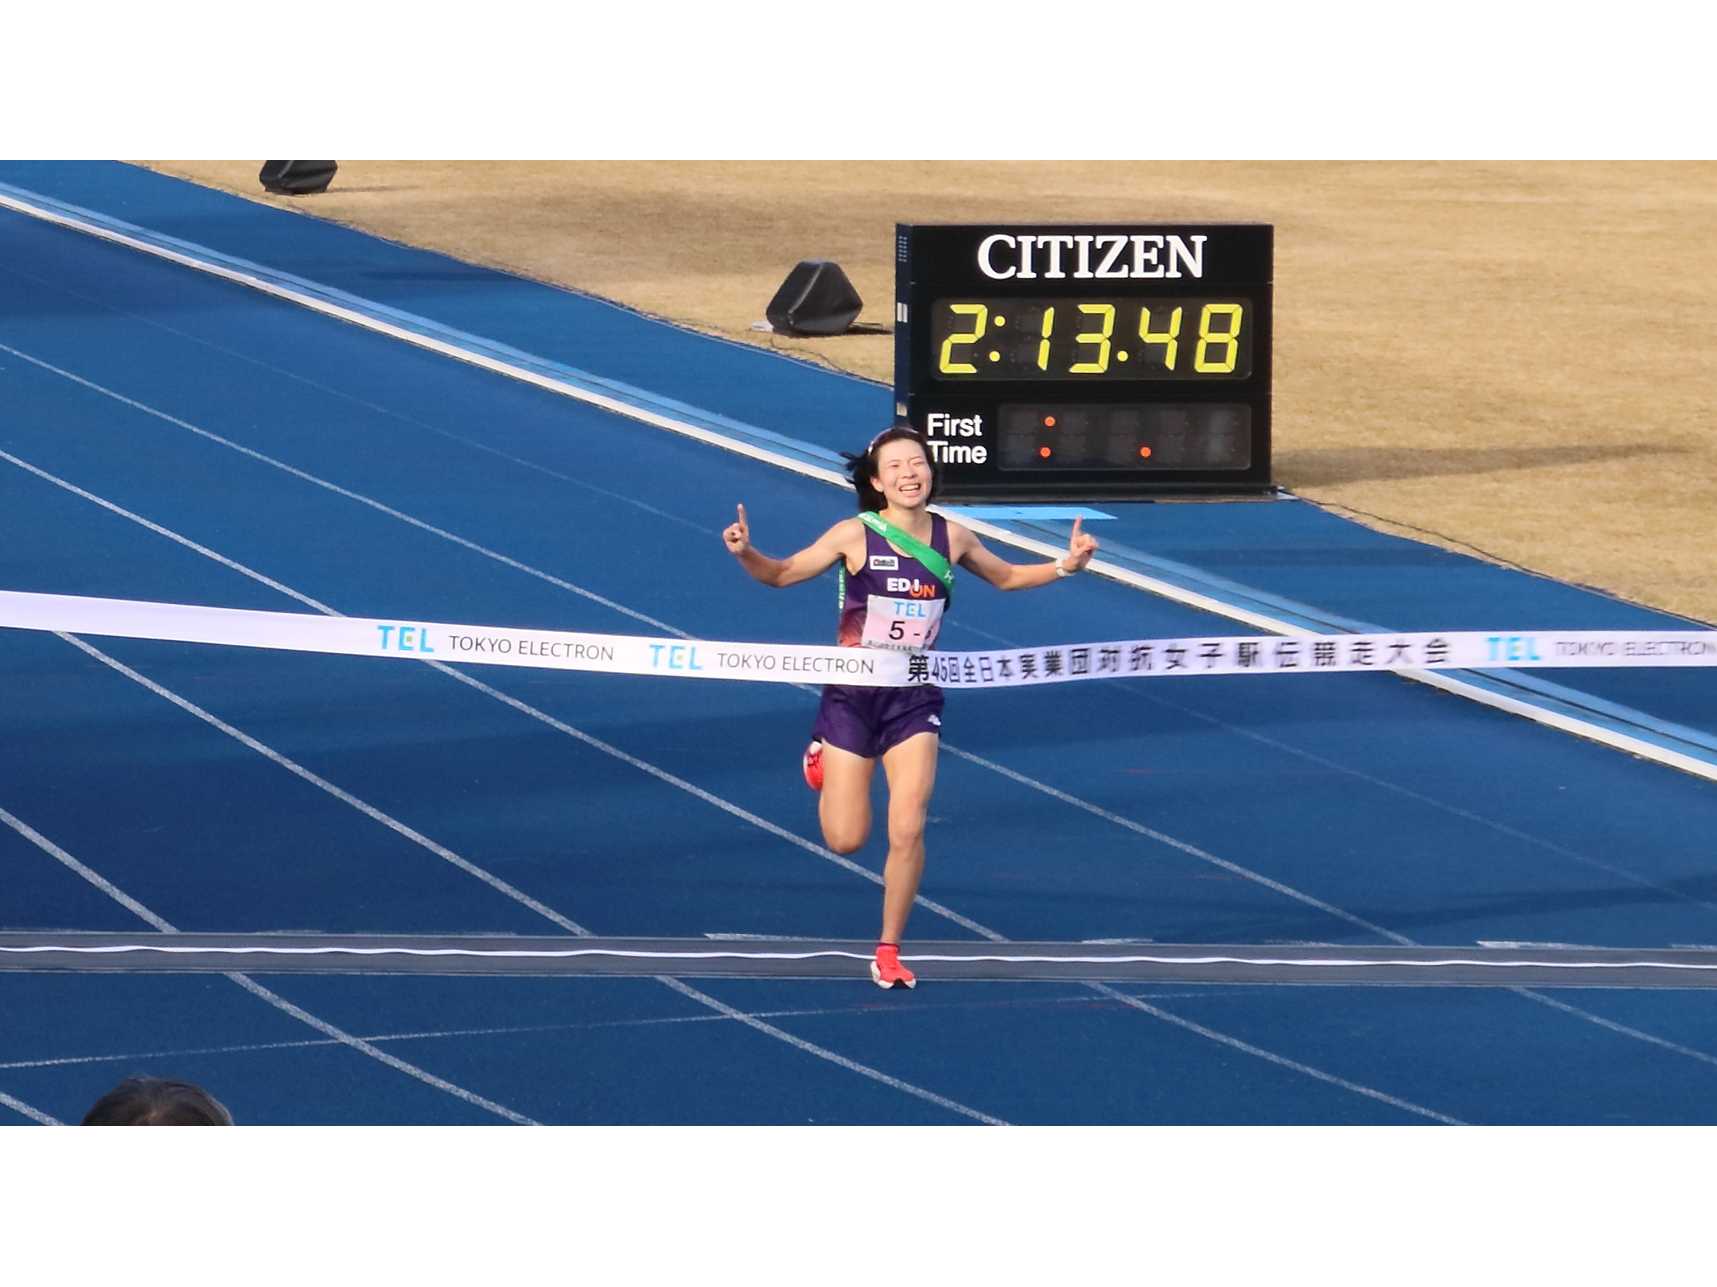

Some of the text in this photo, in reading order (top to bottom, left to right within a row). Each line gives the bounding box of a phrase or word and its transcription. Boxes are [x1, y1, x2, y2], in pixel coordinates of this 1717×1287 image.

[977, 234, 1207, 279] CITIZEN
[939, 303, 1243, 373] 2:13.48
[927, 413, 983, 437] First
[929, 441, 987, 464] Time
[886, 577, 936, 598] EDION
[894, 601, 927, 618] TEL
[377, 625, 614, 661] TEL TOKYO ELECTRON
[1486, 636, 1541, 660] TEL
[649, 643, 874, 674] TEL TOKYO ELECTRON
